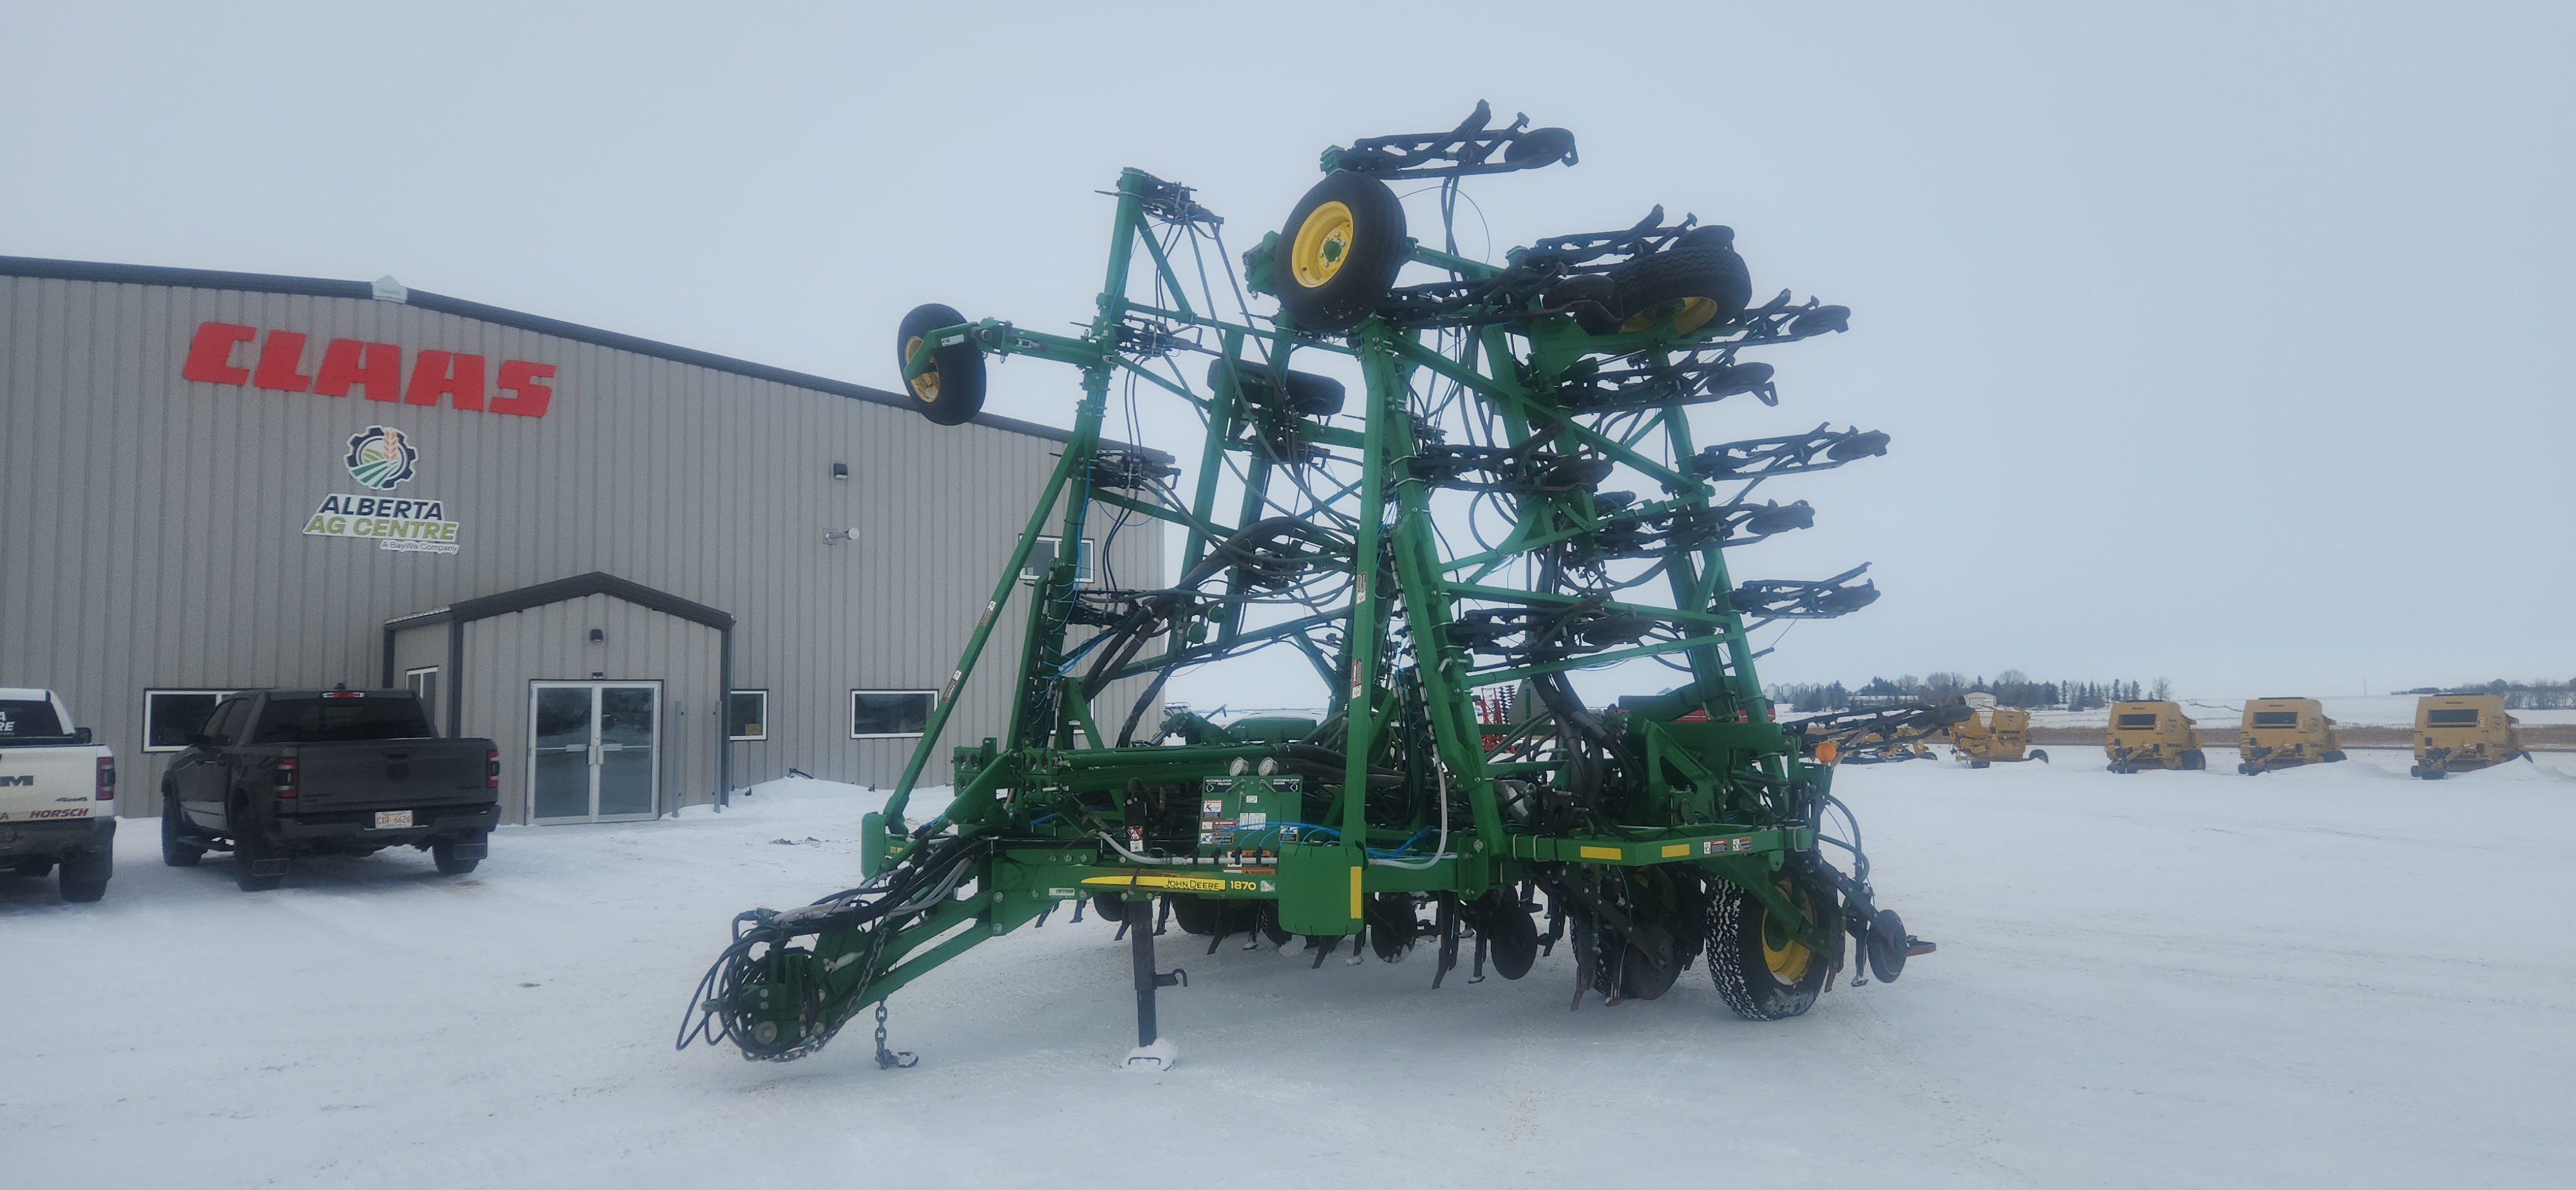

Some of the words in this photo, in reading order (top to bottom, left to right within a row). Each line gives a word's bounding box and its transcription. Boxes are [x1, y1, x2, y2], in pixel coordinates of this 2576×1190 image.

[182, 321, 556, 417] CLAAS
[317, 496, 442, 521] ALBERTA
[305, 515, 346, 534] AG
[353, 518, 457, 540] CENTRE
[390, 542, 418, 551] BayWa
[420, 543, 457, 553] Company
[30, 808, 90, 818] HORSCH
[1165, 878, 1188, 889] JOHN
[1190, 880, 1220, 890] DEERE
[1230, 880, 1256, 891] 1870
